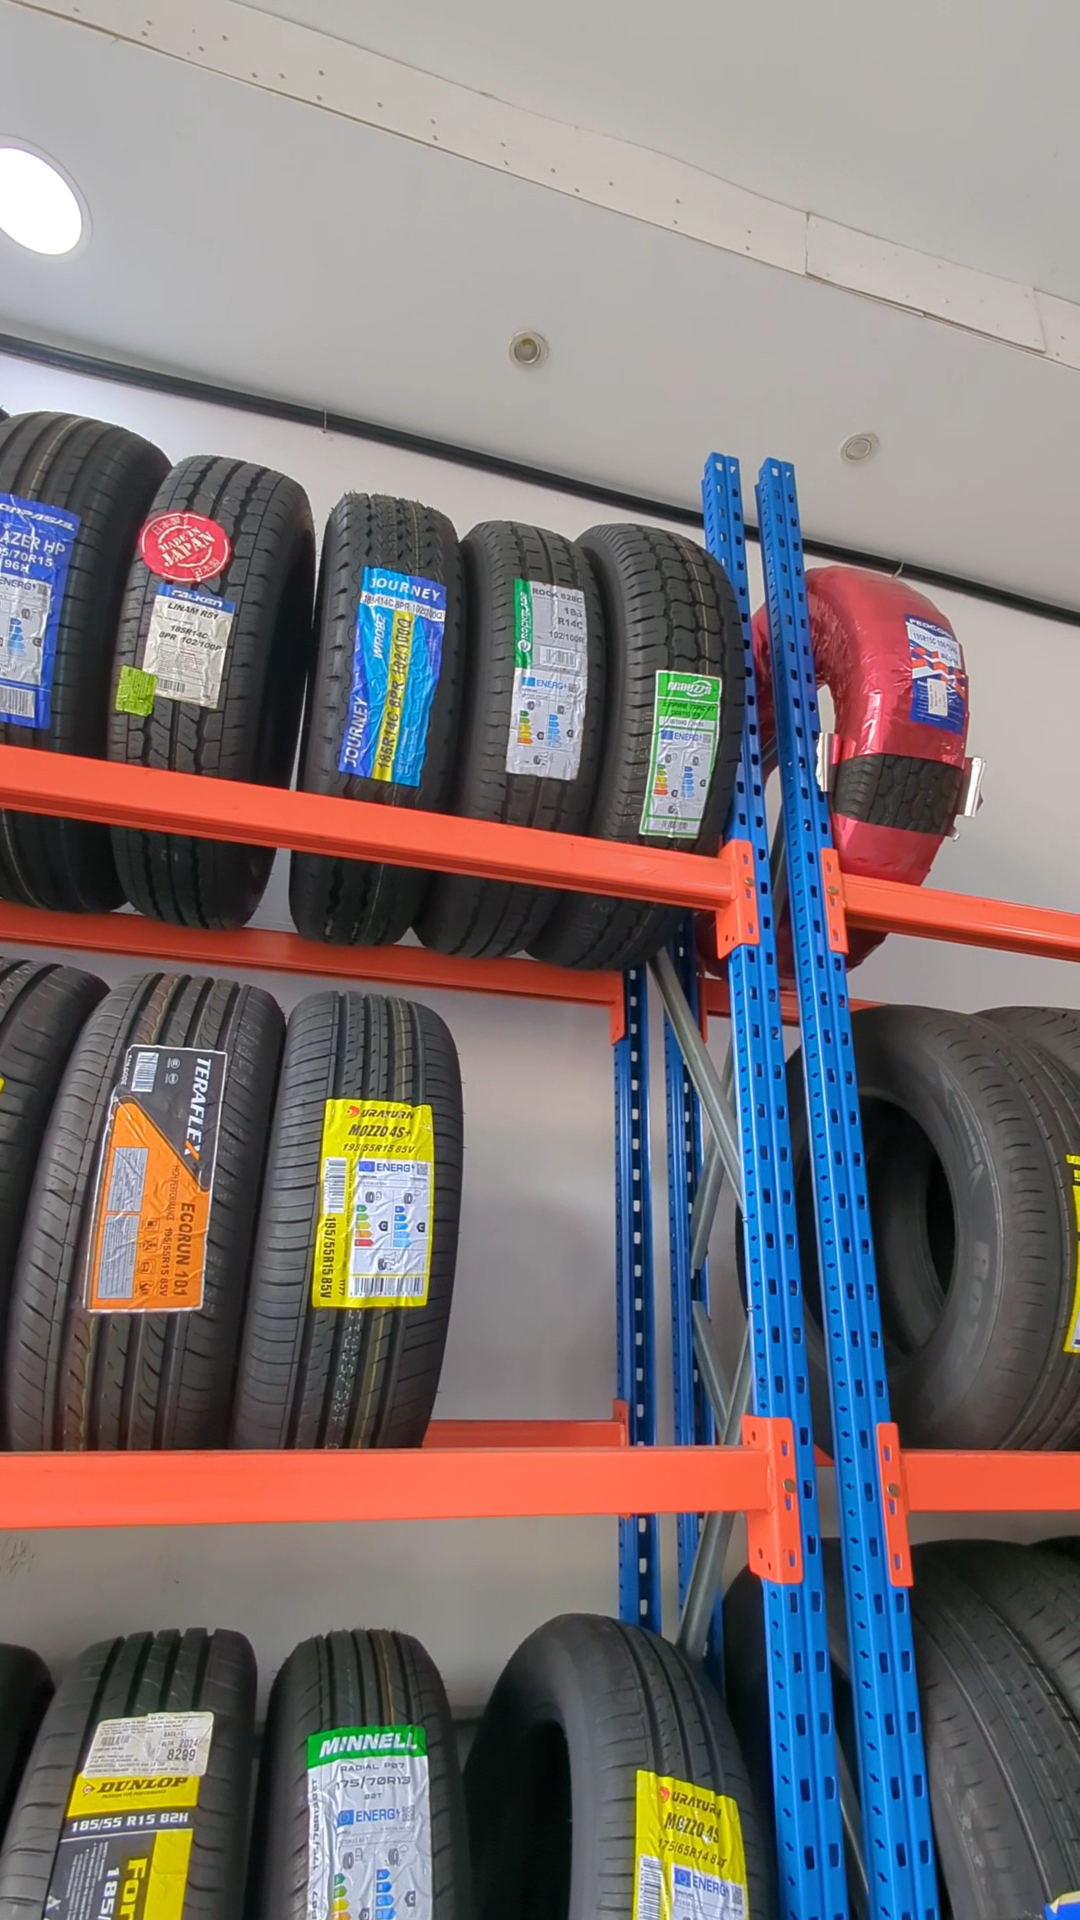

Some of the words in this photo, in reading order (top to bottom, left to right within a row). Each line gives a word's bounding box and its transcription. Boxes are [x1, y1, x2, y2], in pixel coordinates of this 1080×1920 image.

[43, 540, 66, 555] HP
[159, 534, 188, 552] MADE
[162, 531, 215, 567] JAPAN
[0, 547, 53, 567] 5/70R15
[4, 559, 30, 574] 96H
[369, 577, 441, 602] JOURNEY
[532, 587, 559, 598] ROCK
[167, 602, 199, 615] LINAM
[200, 610, 219, 620] R51
[171, 625, 208, 639] 185R14C
[557, 617, 584, 630] R14C
[344, 695, 368, 768] JOURNEY
[377, 711, 399, 769] 185R14C
[389, 681, 405, 708] 8PR
[184, 1058, 211, 1161] TERAFLEX
[348, 1124, 389, 1137] MOZZO
[343, 1143, 395, 1153] 195/55R15
[395, 1145, 416, 1153] 85V
[175, 1202, 195, 1266] ECORUN
[160, 1228, 173, 1276] 195/55R15
[322, 1216, 337, 1276] 195/55R15
[159, 1277, 169, 1296] 85V
[174, 1271, 189, 1296] 101
[320, 1277, 333, 1298] 85V
[167, 1748, 196, 1761] 8299
[319, 1732, 418, 1759] MINNELL
[340, 1763, 379, 1772] RADIAL
[97, 1777, 188, 1794] DUNLOP
[336, 1775, 411, 1791] 175/70R13
[72, 1817, 123, 1833] 185/55
[126, 1814, 156, 1827] R15
[160, 1812, 189, 1824] 82H
[664, 1812, 705, 1838] MOZZO
[658, 1838, 709, 1862] 175/65R14
